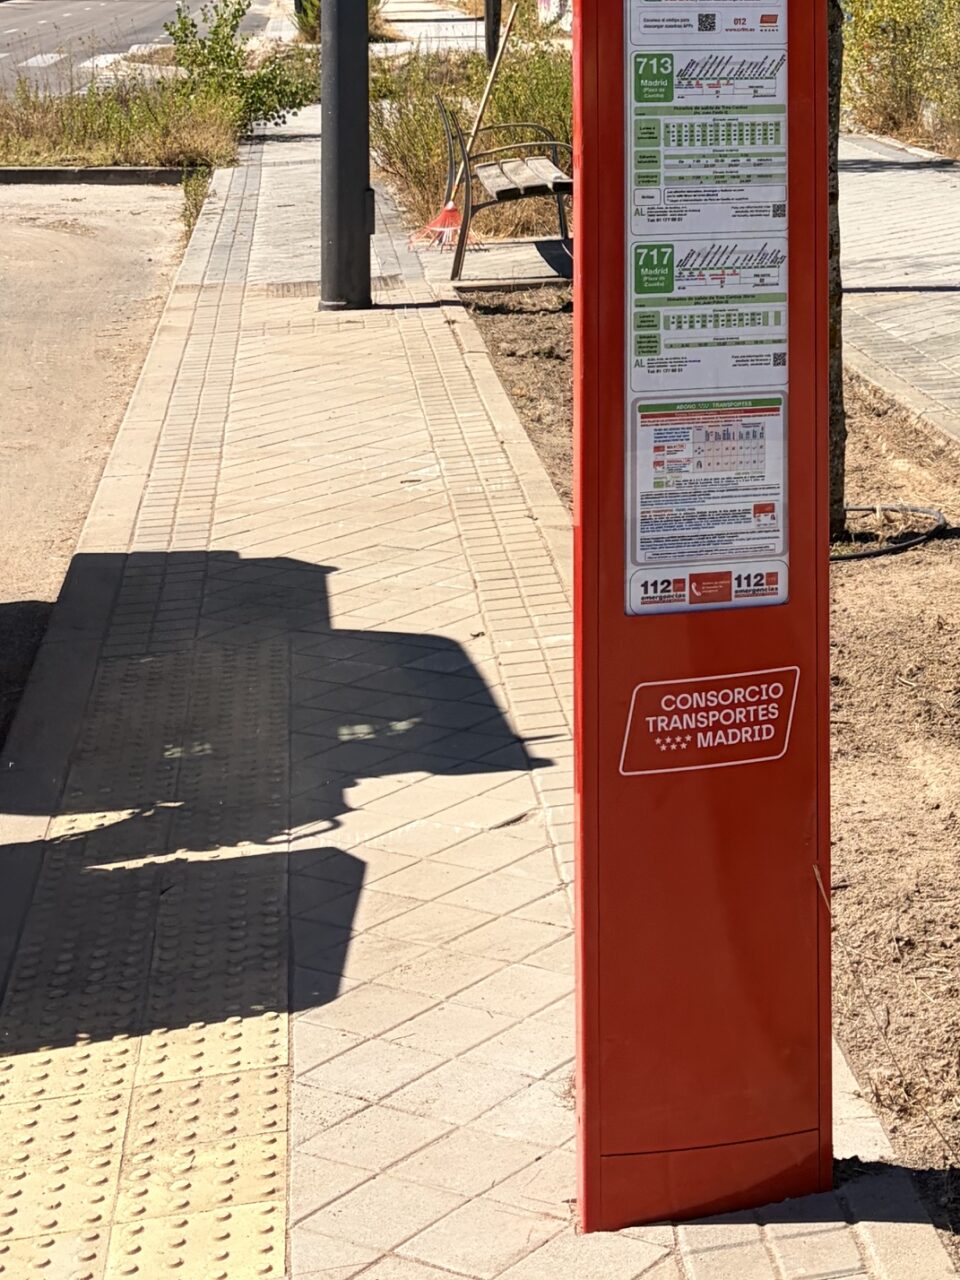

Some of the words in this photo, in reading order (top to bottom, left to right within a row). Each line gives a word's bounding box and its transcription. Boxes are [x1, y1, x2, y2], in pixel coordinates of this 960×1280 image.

[635, 58, 672, 75] 713
[640, 79, 667, 87] Madrid
[636, 248, 672, 265] 717
[640, 267, 668, 275] Madrid
[640, 579, 671, 595] 112
[734, 573, 765, 588] 112
[640, 593, 686, 601] emergencias
[734, 586, 779, 594] emergencias
[661, 682, 784, 711] CONSORCIO
[645, 703, 779, 733] TRANSPORTES
[697, 724, 775, 748] MADRID
